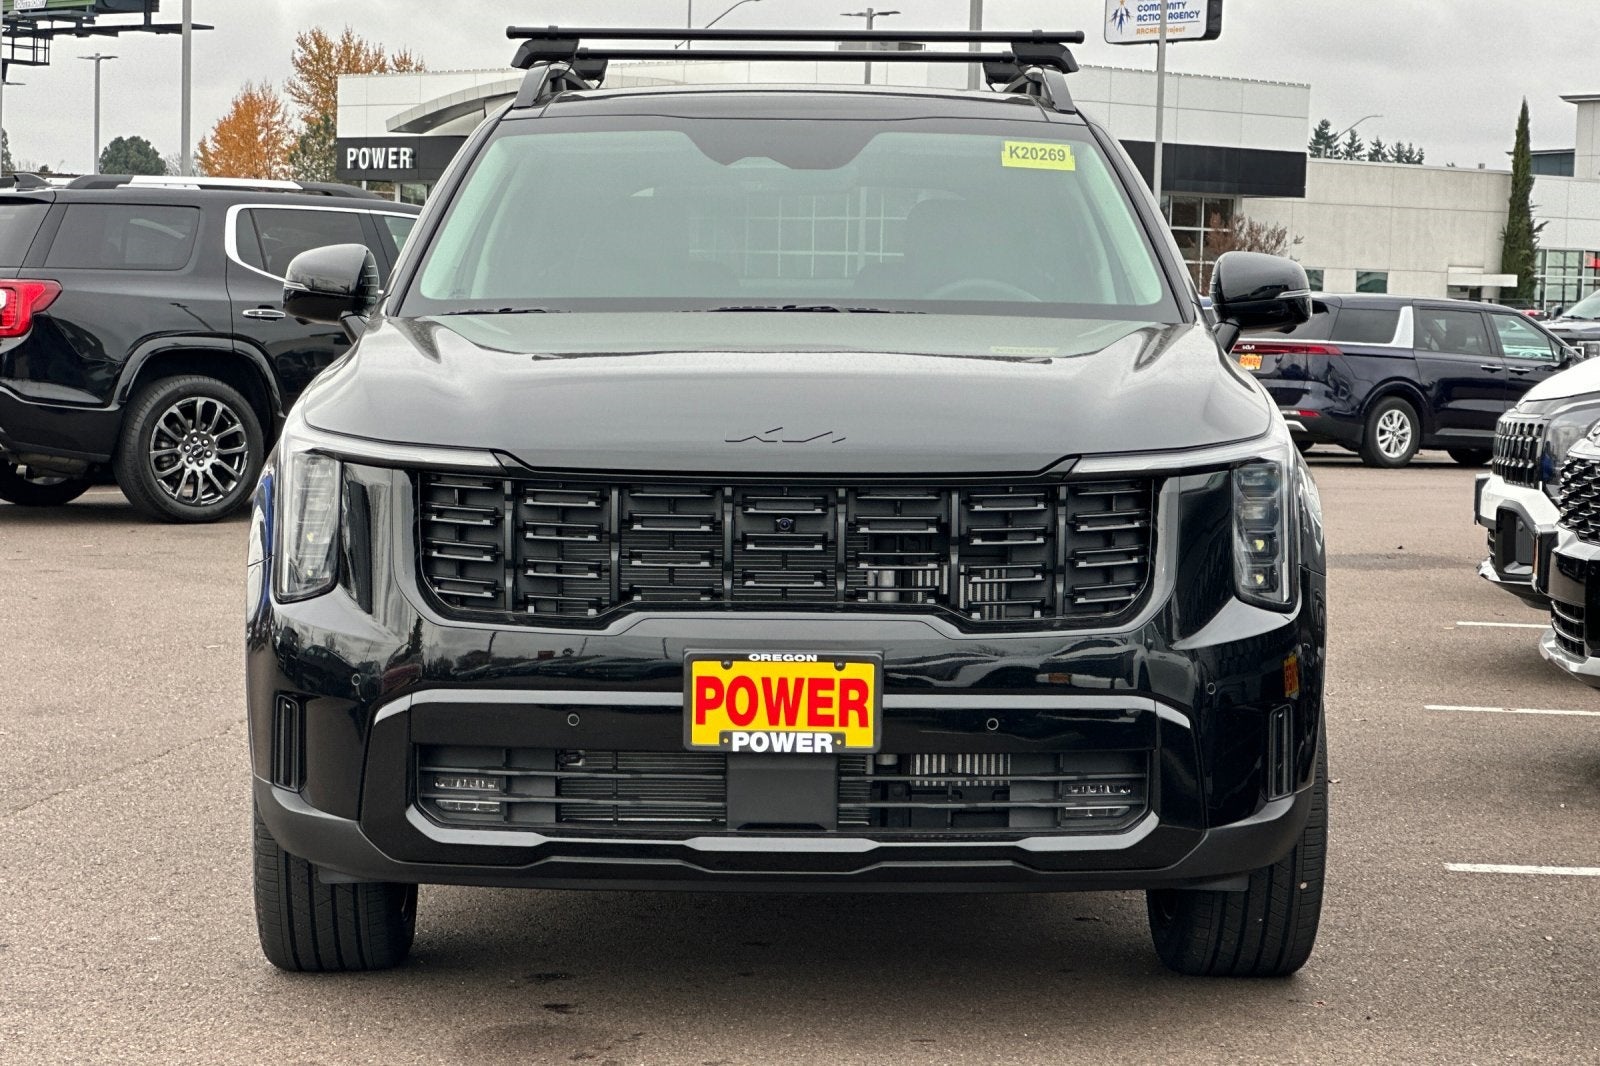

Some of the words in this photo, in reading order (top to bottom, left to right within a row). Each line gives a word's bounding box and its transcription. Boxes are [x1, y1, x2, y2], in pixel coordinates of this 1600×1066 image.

[1137, 13, 1161, 22] ACTIO
[1168, 10, 1200, 20] AGENCY
[1167, 25, 1185, 34] roject
[346, 147, 412, 169] POWER
[1009, 145, 1066, 162] K20269
[748, 653, 818, 662] OREGON
[695, 675, 869, 728] POWER
[731, 731, 833, 753] POWER
